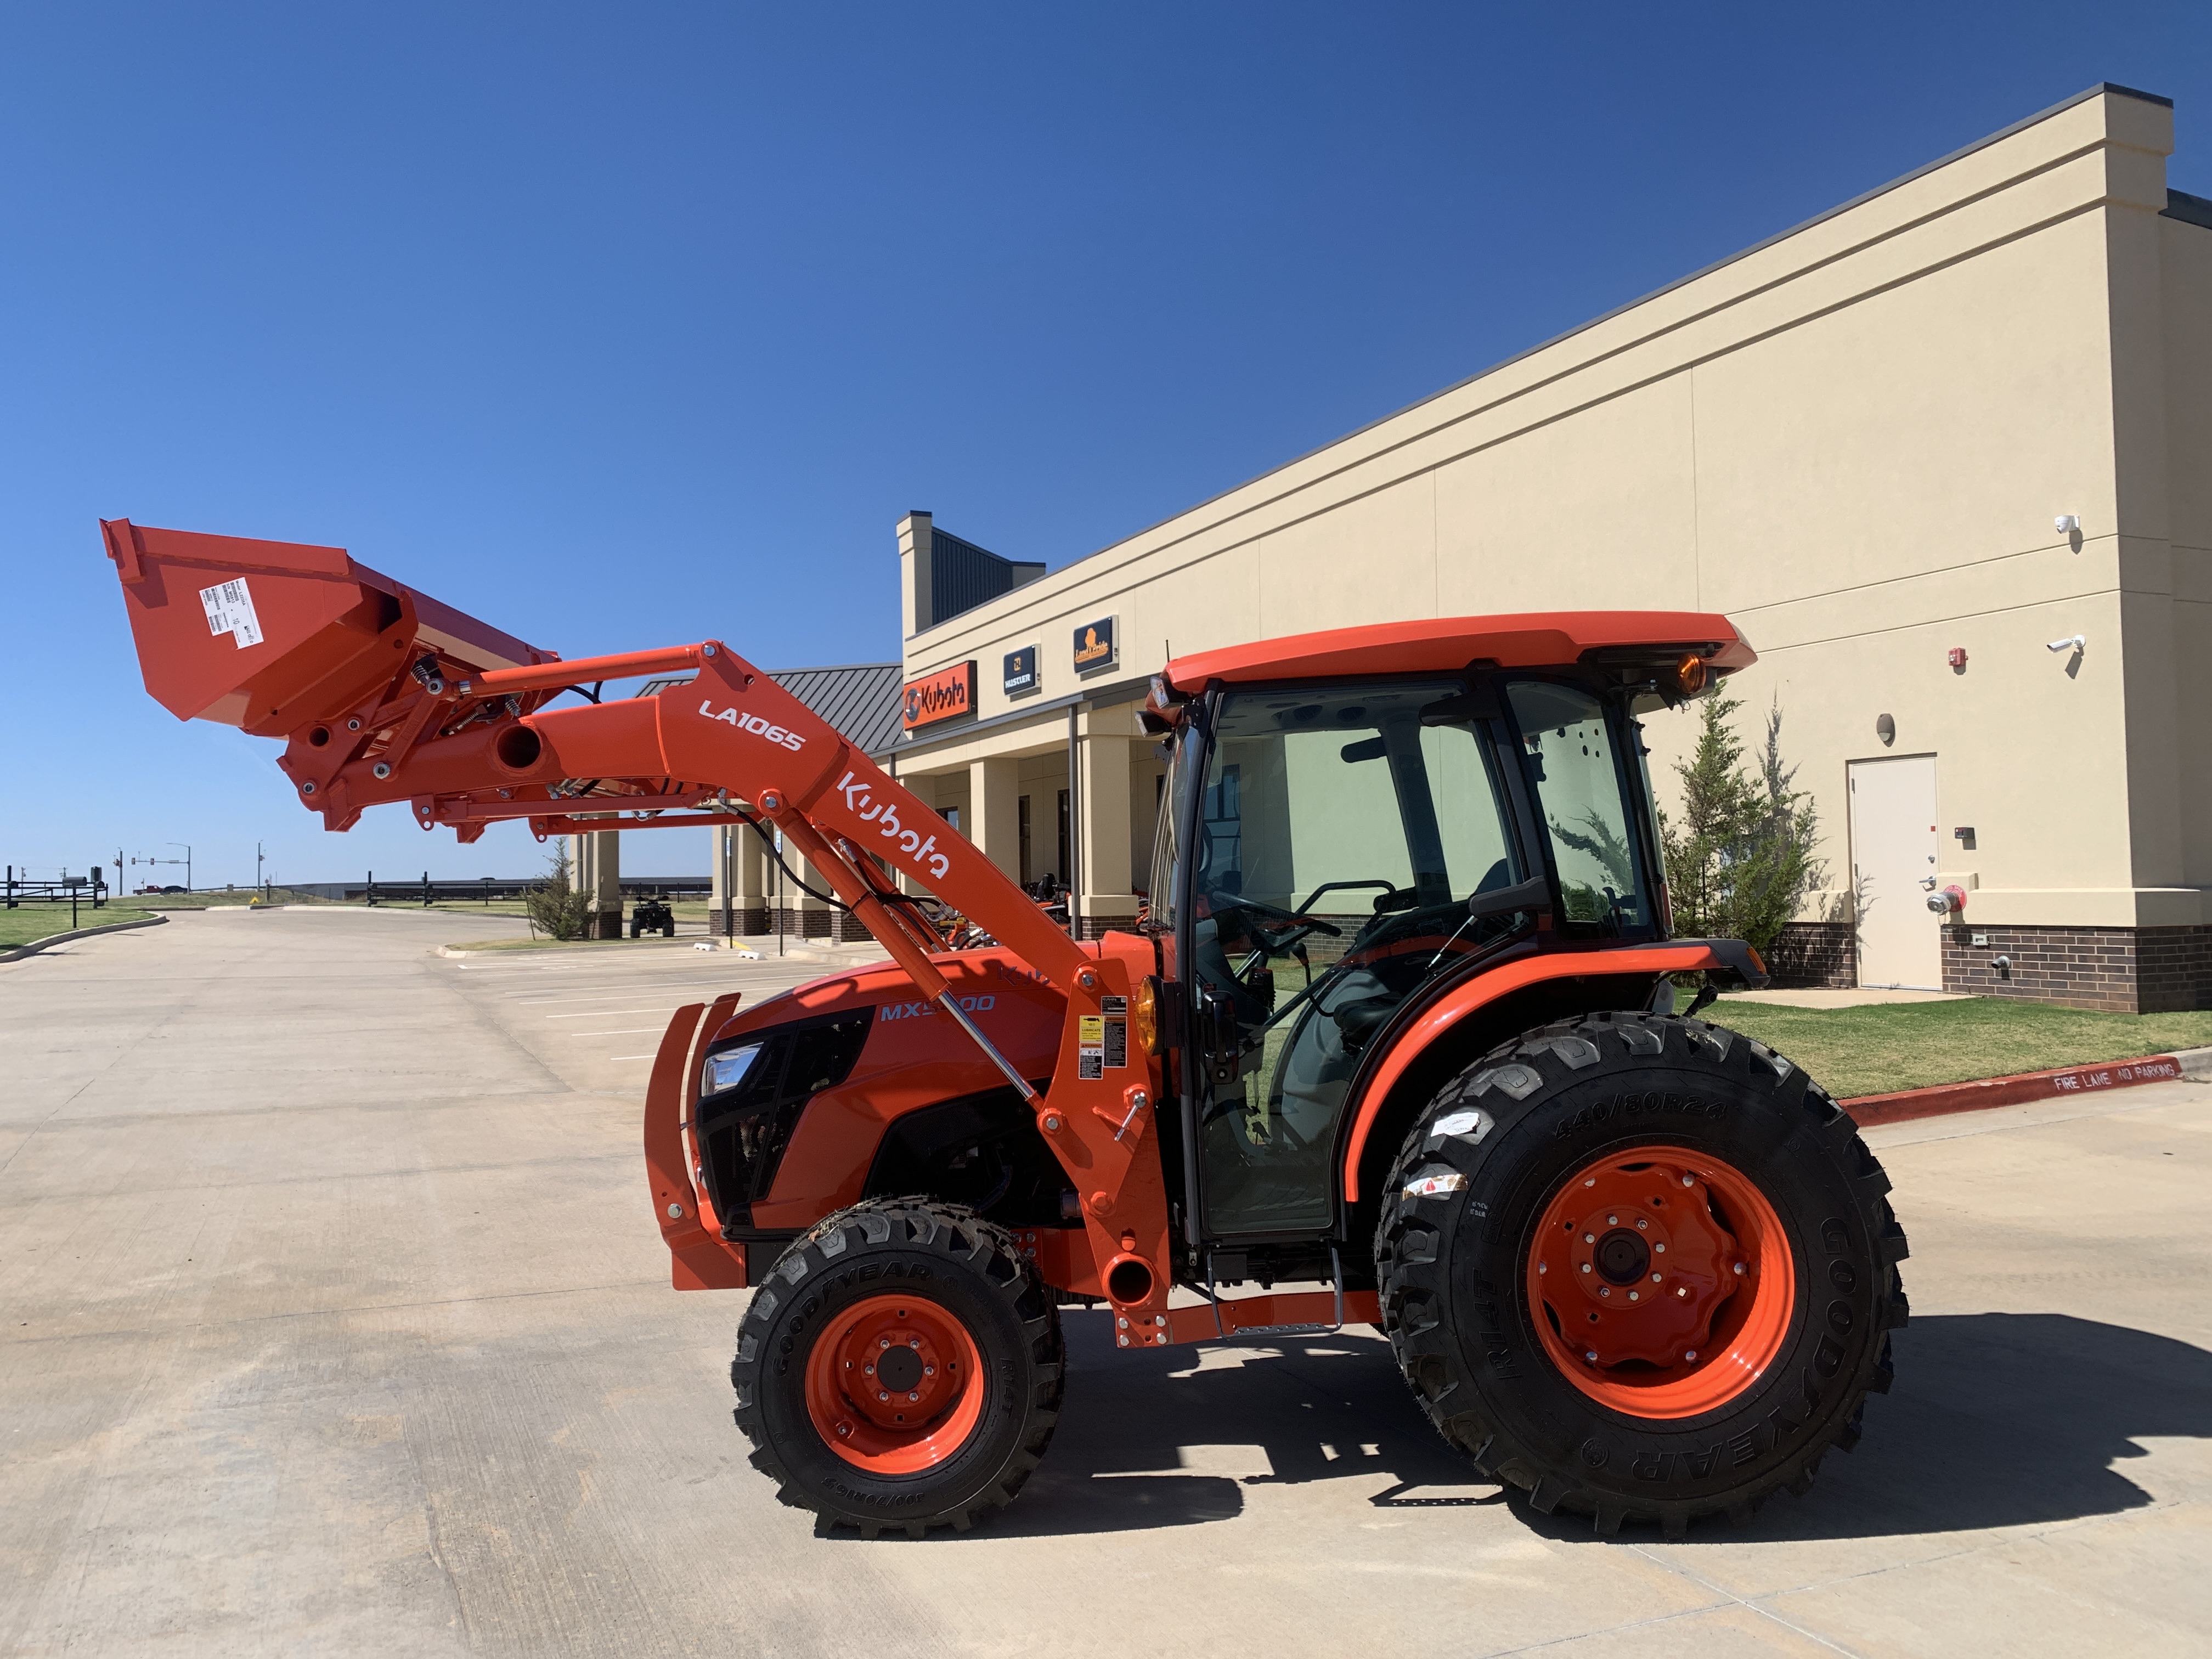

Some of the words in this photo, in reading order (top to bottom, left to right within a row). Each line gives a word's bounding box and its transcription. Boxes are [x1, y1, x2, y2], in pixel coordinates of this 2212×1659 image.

[921, 676, 965, 713] Kubota
[1005, 674, 1031, 689] HUSTLER
[698, 699, 806, 752] LA1065
[837, 771, 950, 879] Kubota
[2054, 1076, 2080, 1091] FIRE
[2082, 1073, 2112, 1087] LANE
[2117, 1068, 2133, 1081] NO
[2135, 1063, 2175, 1078] PARKING
[773, 1261, 933, 1376] GOODYEAR
